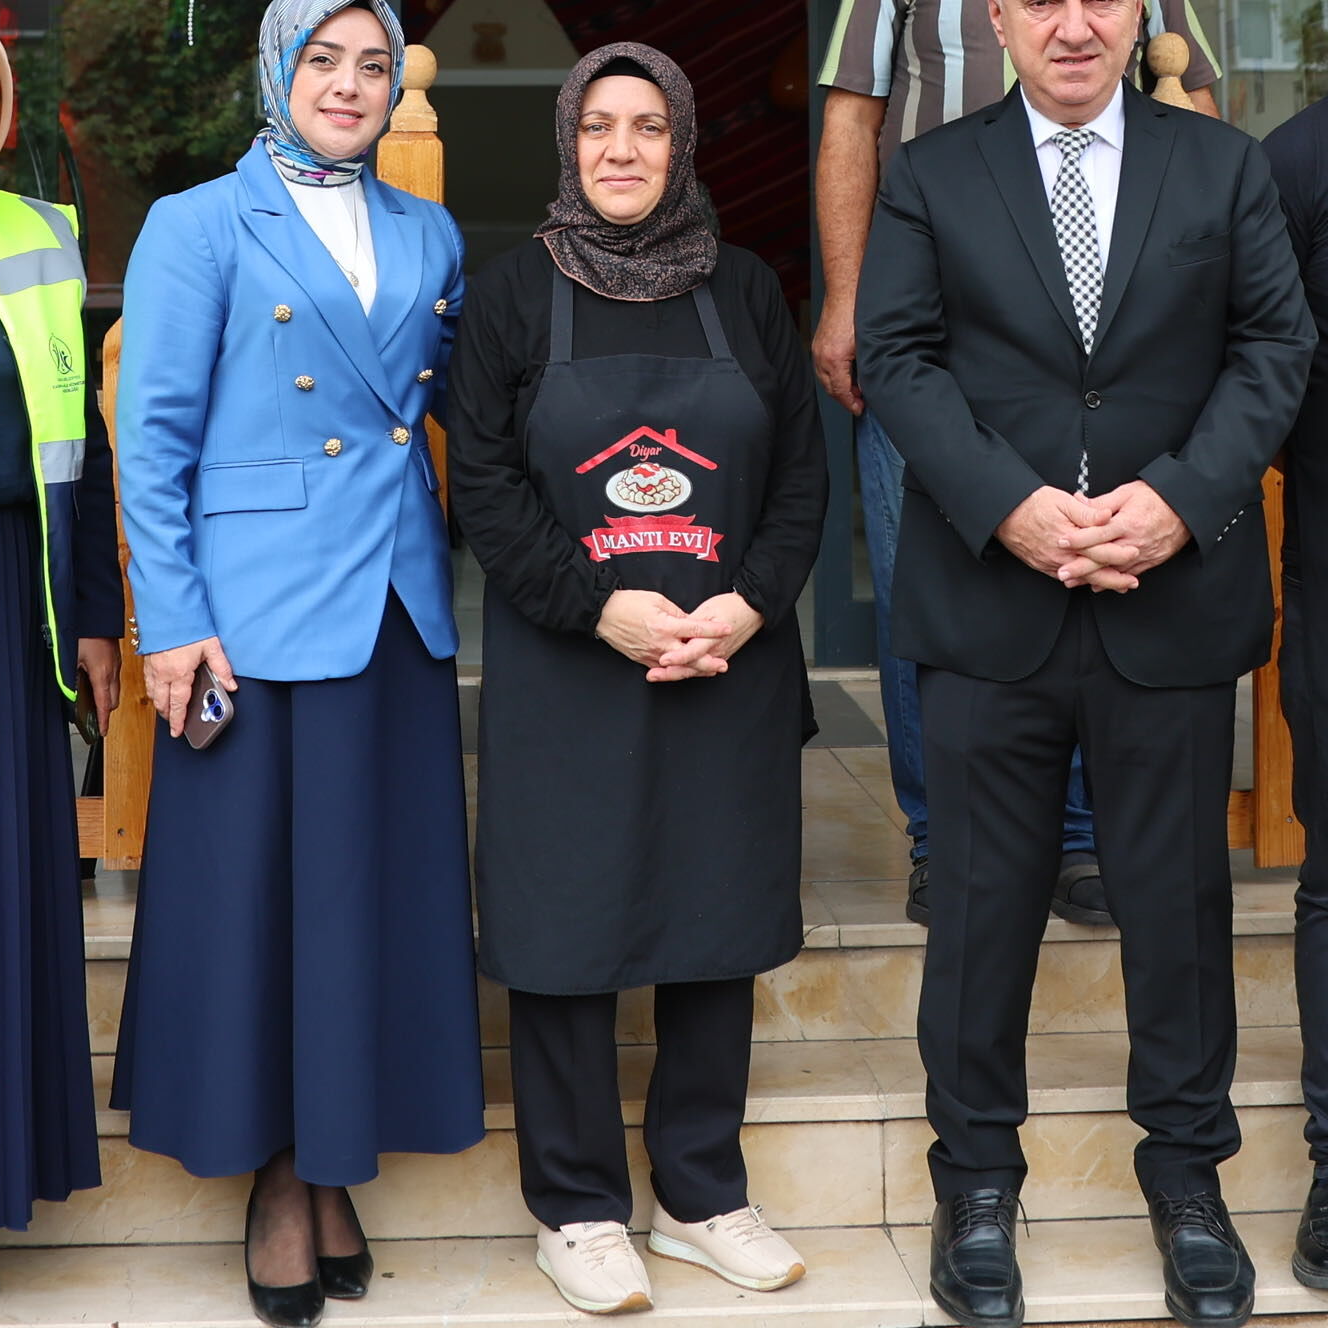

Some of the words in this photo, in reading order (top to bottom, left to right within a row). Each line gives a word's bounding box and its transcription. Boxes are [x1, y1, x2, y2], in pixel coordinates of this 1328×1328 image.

[629, 444, 662, 461] Diyar
[602, 531, 662, 549] MANTI
[668, 529, 704, 549] EVİ
